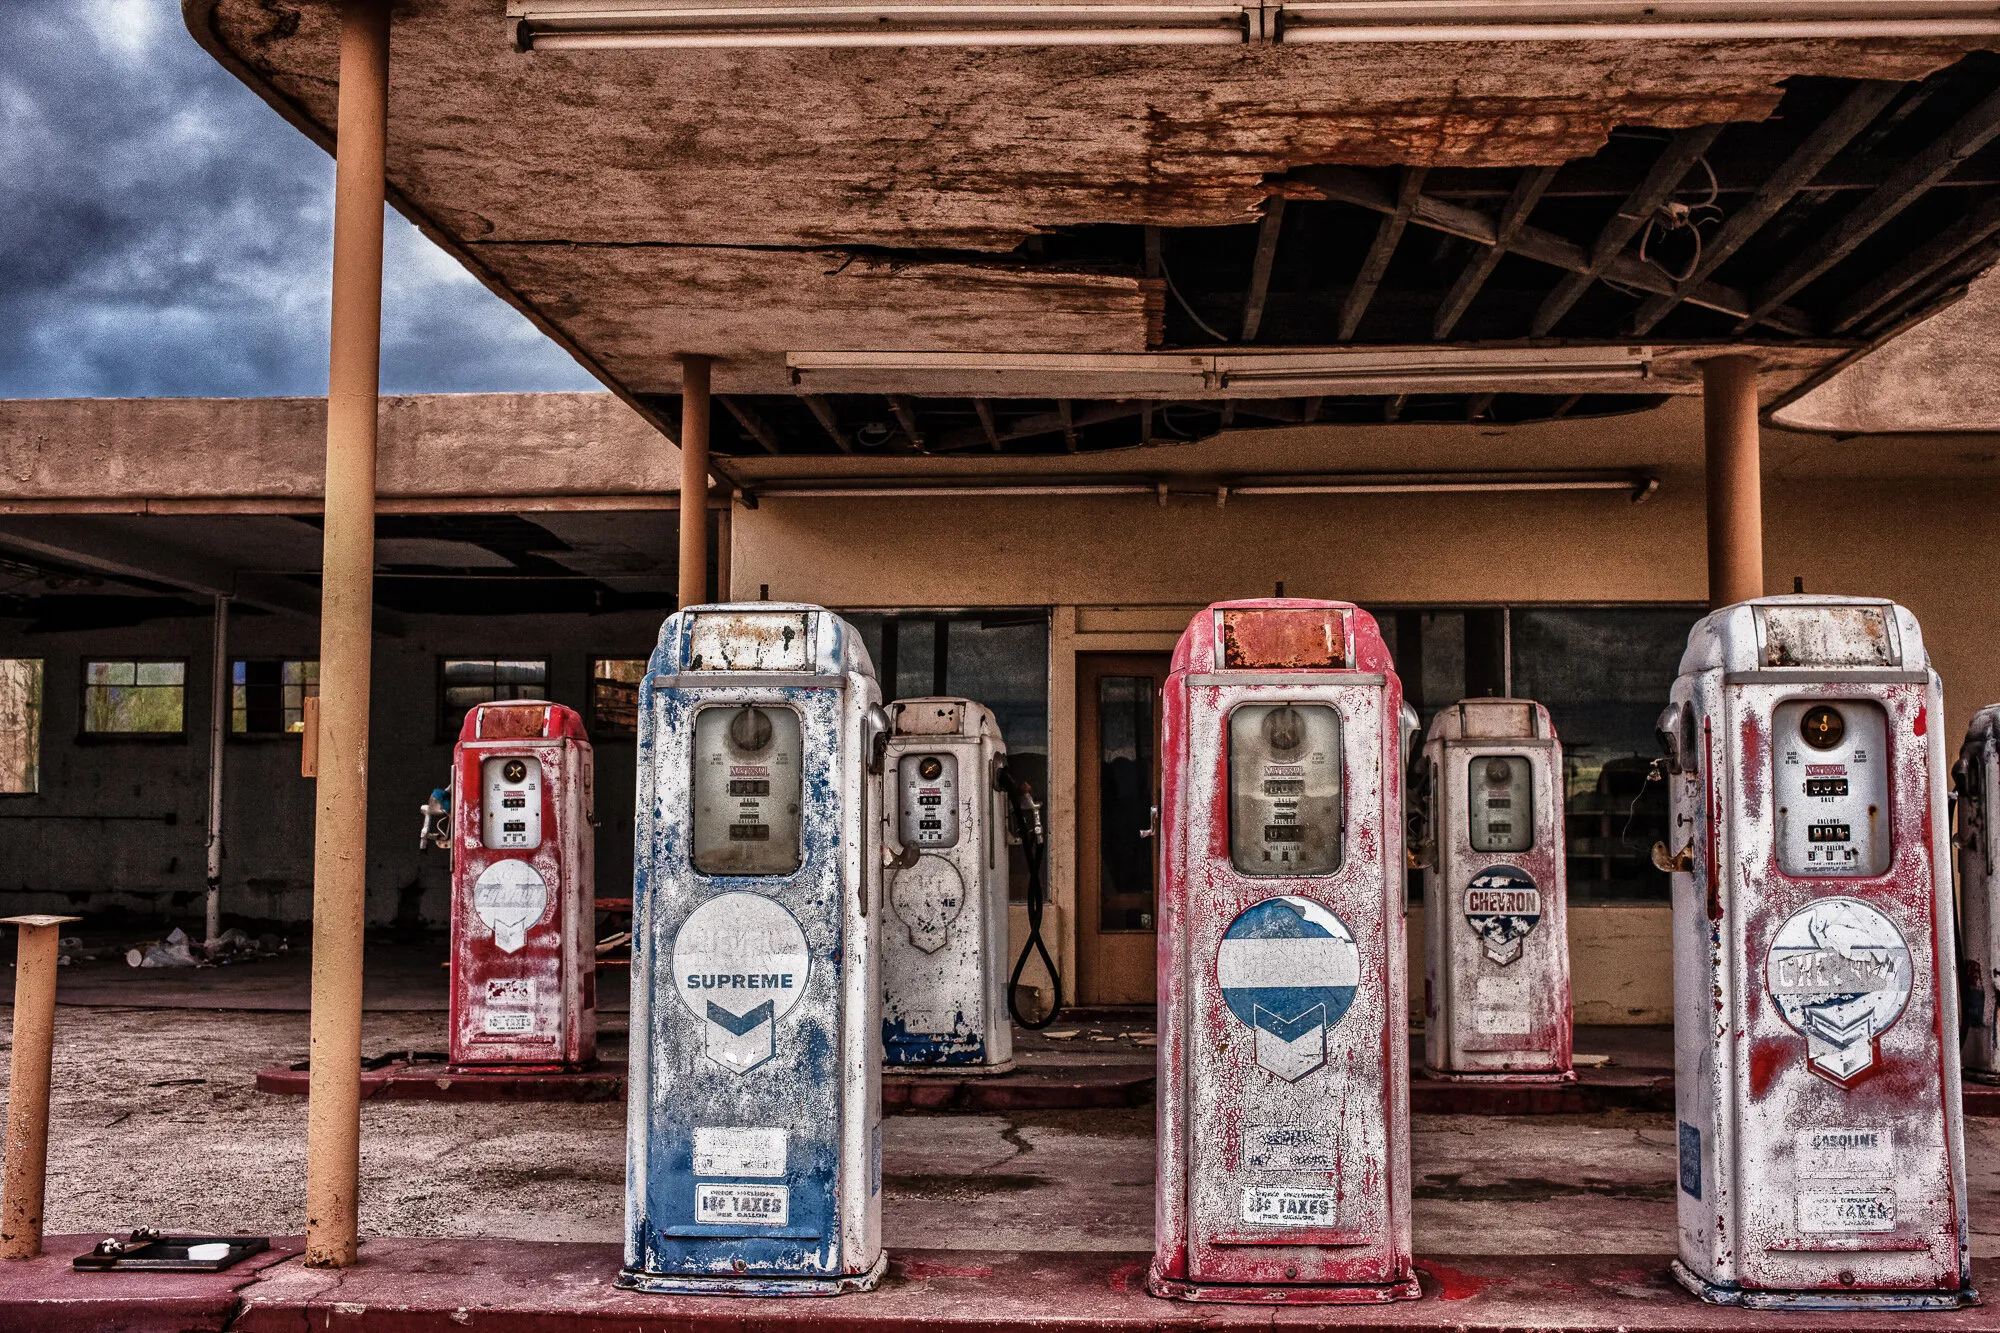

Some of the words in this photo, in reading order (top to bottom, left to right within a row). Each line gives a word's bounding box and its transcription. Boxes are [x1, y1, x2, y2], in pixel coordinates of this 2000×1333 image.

[1470, 892, 1536, 912] CHEVRON
[687, 973, 793, 989] SUPREME
[1812, 1133, 1878, 1147] GASOLINE
[732, 1196, 781, 1213] TAXES
[1278, 1198, 1329, 1215] TAXES
